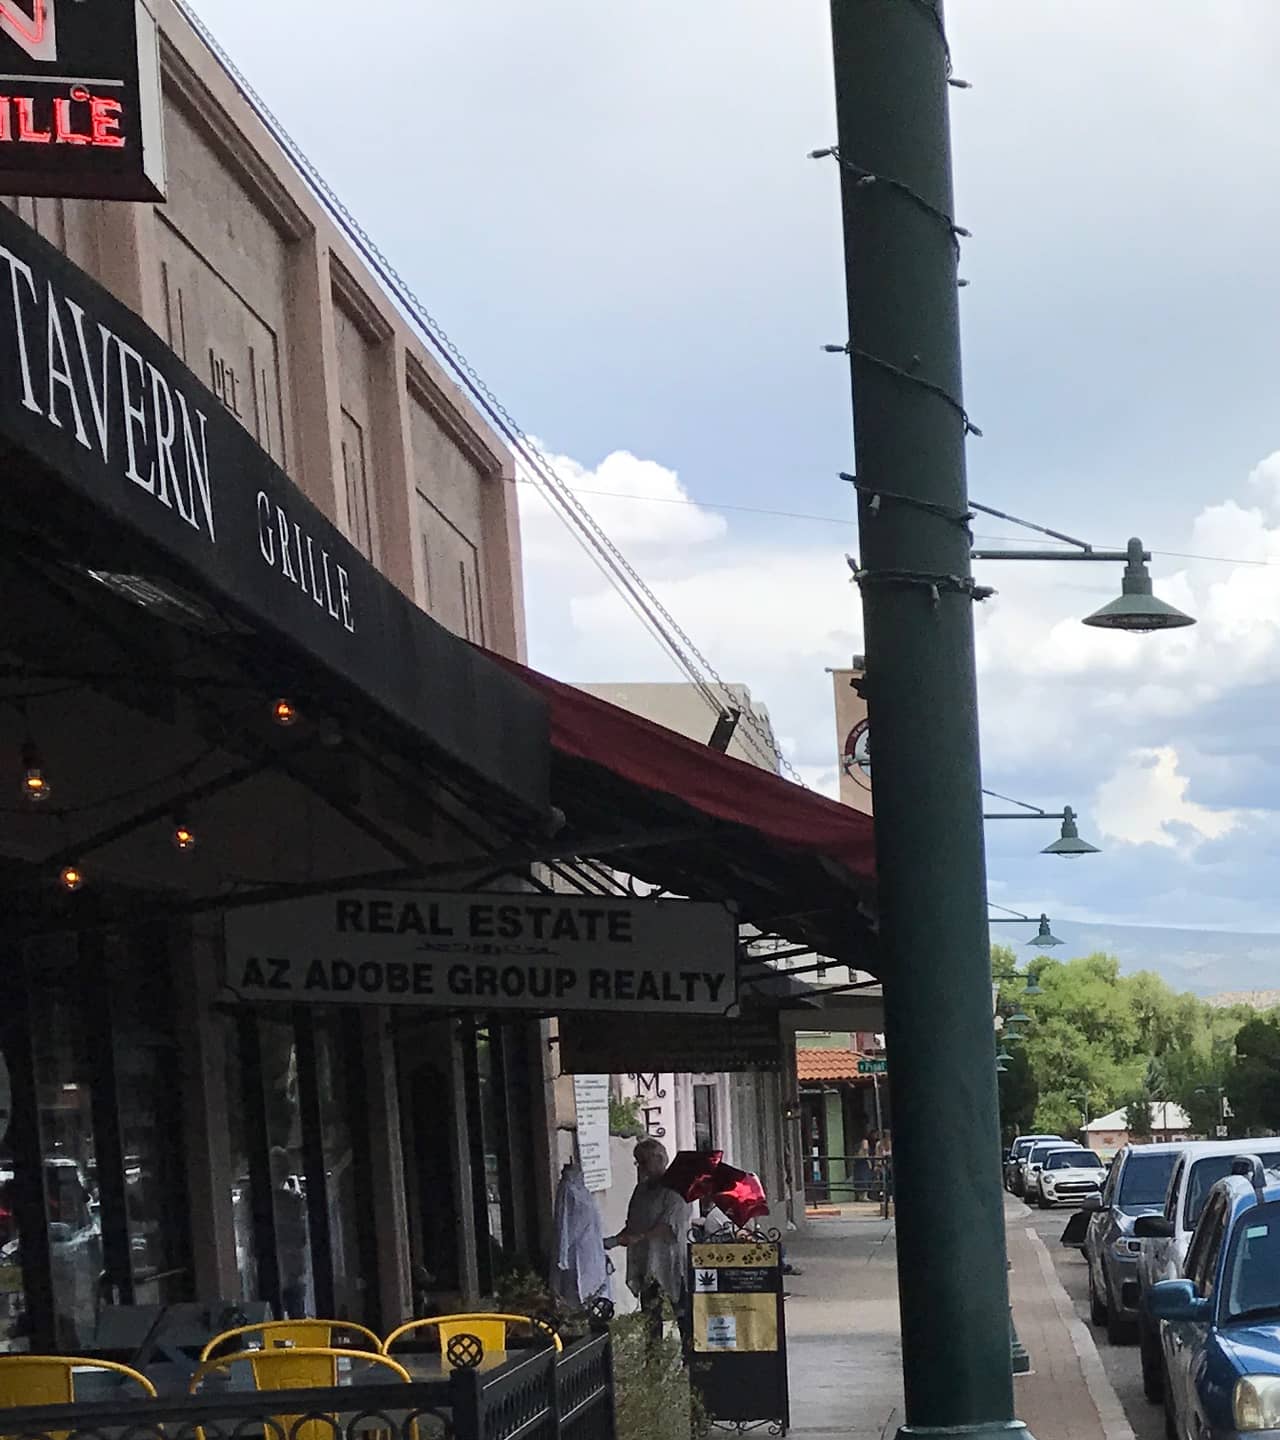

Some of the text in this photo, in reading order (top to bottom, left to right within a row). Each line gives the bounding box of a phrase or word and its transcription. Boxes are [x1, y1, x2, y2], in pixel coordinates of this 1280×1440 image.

[0, 246, 356, 633] TAVERN GRILLE
[335, 899, 633, 943] REAL ESTATE
[241, 957, 726, 1003] AZ ADOBE GROUP REALTY
